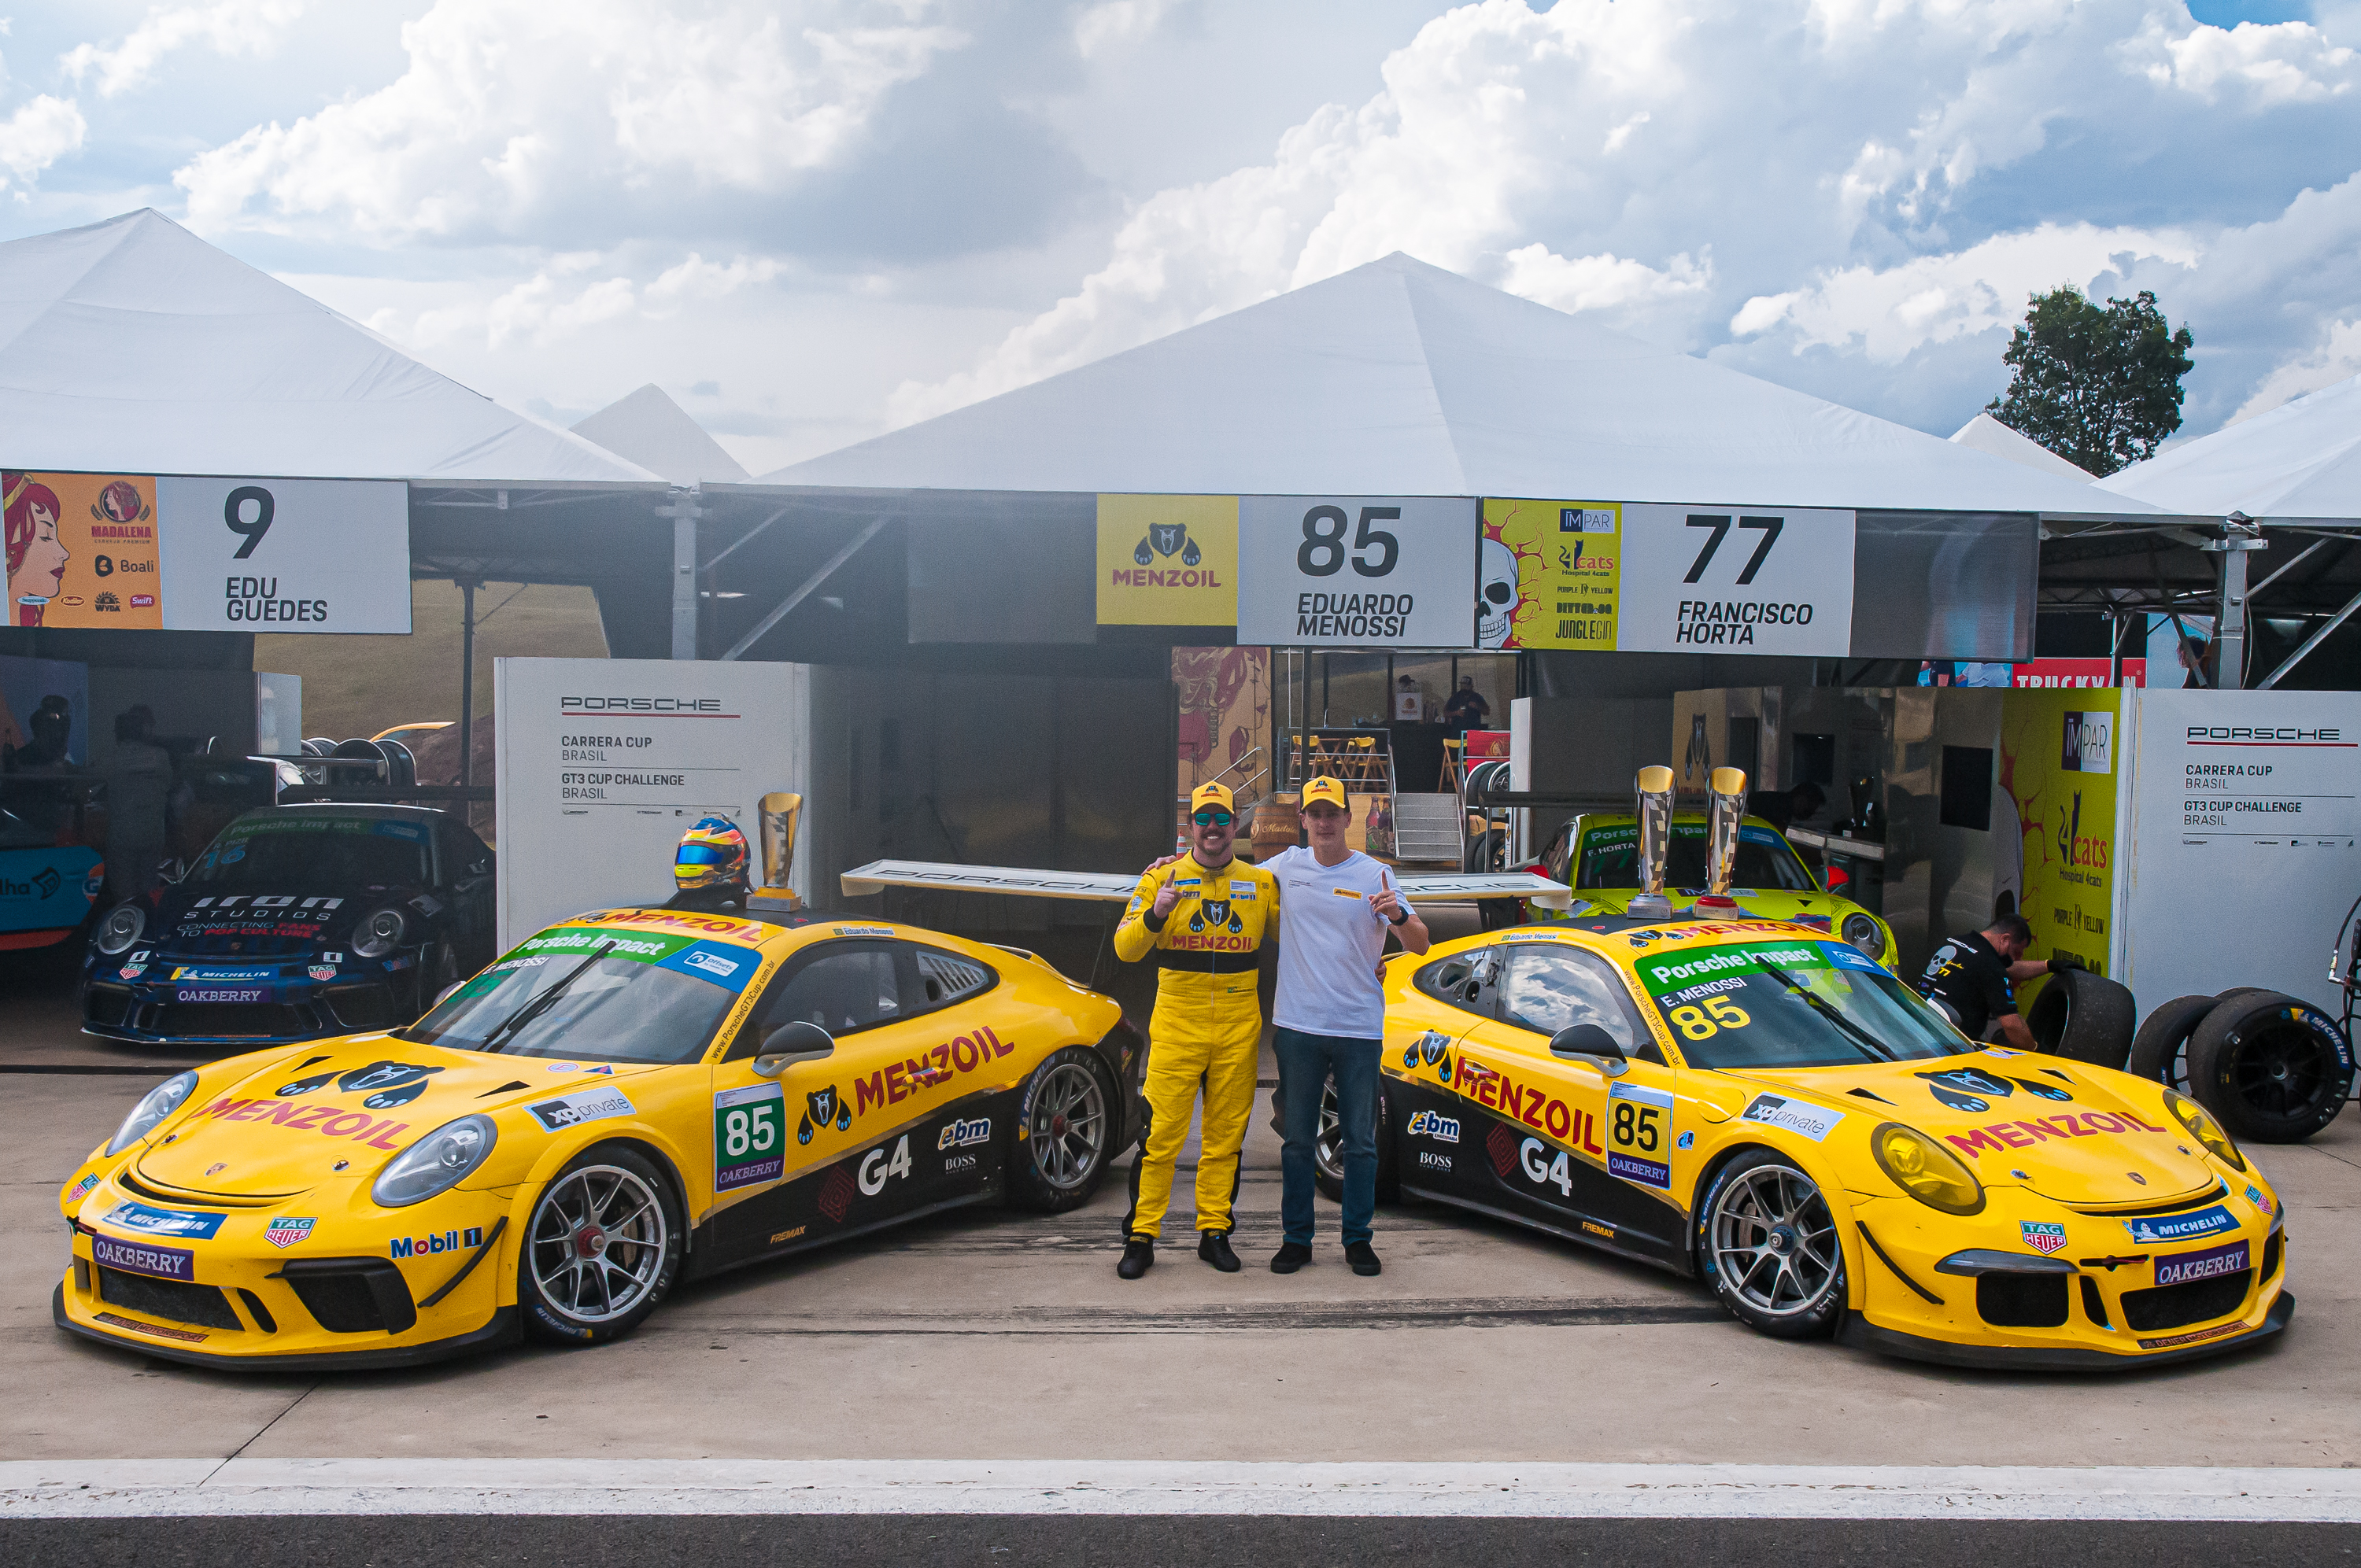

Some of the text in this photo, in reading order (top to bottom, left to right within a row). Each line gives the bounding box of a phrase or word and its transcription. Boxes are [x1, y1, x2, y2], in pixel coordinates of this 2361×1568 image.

[91, 526, 152, 538] MADALENA
[224, 485, 275, 559] 9
[1297, 505, 1401, 577] 85
[1682, 514, 1785, 585] 77
[120, 559, 154, 573] Boali
[227, 577, 277, 599] EDU
[1112, 569, 1221, 588] MENZOIL
[227, 600, 328, 622] GUEDES
[1297, 593, 1413, 615] EDUARDO
[1676, 601, 1813, 625] FRANCISCO
[1297, 615, 1406, 637] MENOSSI
[1676, 623, 1754, 645] HORTA
[561, 696, 721, 711] PORSCHE
[562, 736, 652, 747] CARRERA CUP
[2187, 727, 2341, 740] PORSCHE
[562, 749, 608, 761] BRASIL
[562, 773, 685, 786] GT3 CUP CHALLENGE
[2185, 764, 2273, 777] CARRERA CUP
[562, 787, 608, 799] BRASIL
[2185, 778, 2229, 789] BRASIL
[2183, 801, 2302, 813] GT3 CUP CHALLENGE
[2184, 814, 2227, 826] BRASIL
[1591, 828, 1638, 842] Porsc
[203, 845, 246, 868] 16
[1598, 842, 1636, 853] HORTA
[2059, 865, 2084, 885] Hospital
[183, 909, 331, 921] STUDIOS
[2053, 907, 2104, 935] PURPLE YELLOW
[177, 921, 274, 932] CONNECTING
[603, 912, 763, 943] MENZOIL
[1674, 921, 1827, 938] MENZOIL
[515, 932, 592, 953] Porsche
[493, 957, 552, 972] MENOSSI
[1651, 954, 1746, 984] Porsche
[178, 990, 262, 1002] OAKBERRY
[1660, 976, 1748, 1008] E. MENOSSI
[1624, 968, 1681, 1067] www.PorscheGT3Cup.com.br
[1669, 994, 1751, 1041] 85
[2311, 1016, 2349, 1064] MICHELIN
[854, 1025, 1014, 1117] MENZOIL
[1023, 1053, 1055, 1112] MICHELIN
[577, 1097, 630, 1119] private
[1454, 1055, 1603, 1155] MENZOIL
[190, 1098, 410, 1150] MENZOIL
[726, 1105, 775, 1157] 85
[1410, 1112, 1459, 1134] ebm
[1613, 1102, 1660, 1153] 85
[1772, 1109, 1824, 1134] private
[1945, 1110, 2168, 1159] MENZOIL
[858, 1134, 912, 1196] G4
[945, 1153, 976, 1171] BOSS
[1420, 1152, 1452, 1168] BOSS
[1520, 1137, 1572, 1197] G4
[1611, 1157, 1667, 1181] OAKBERRY
[719, 1160, 781, 1184] OAKBERRY
[1702, 1175, 1724, 1216] MICHELIN
[275, 1219, 312, 1228] TAG
[1582, 1221, 1615, 1239] FREMAX
[2027, 1223, 2061, 1234] TAG
[2159, 1214, 2227, 1235] MICHELIN
[268, 1230, 309, 1245] HEUER
[390, 1230, 458, 1259] Mobil
[770, 1225, 807, 1245] FREMAX
[2025, 1234, 2064, 1251] HEUER
[96, 1241, 186, 1274] OAKBERRY
[2160, 1250, 2245, 1283] OAKBERRY
[138, 1323, 204, 1341] MOTORSPORT
[2155, 1322, 2249, 1347] DENER MOTORSPORT
